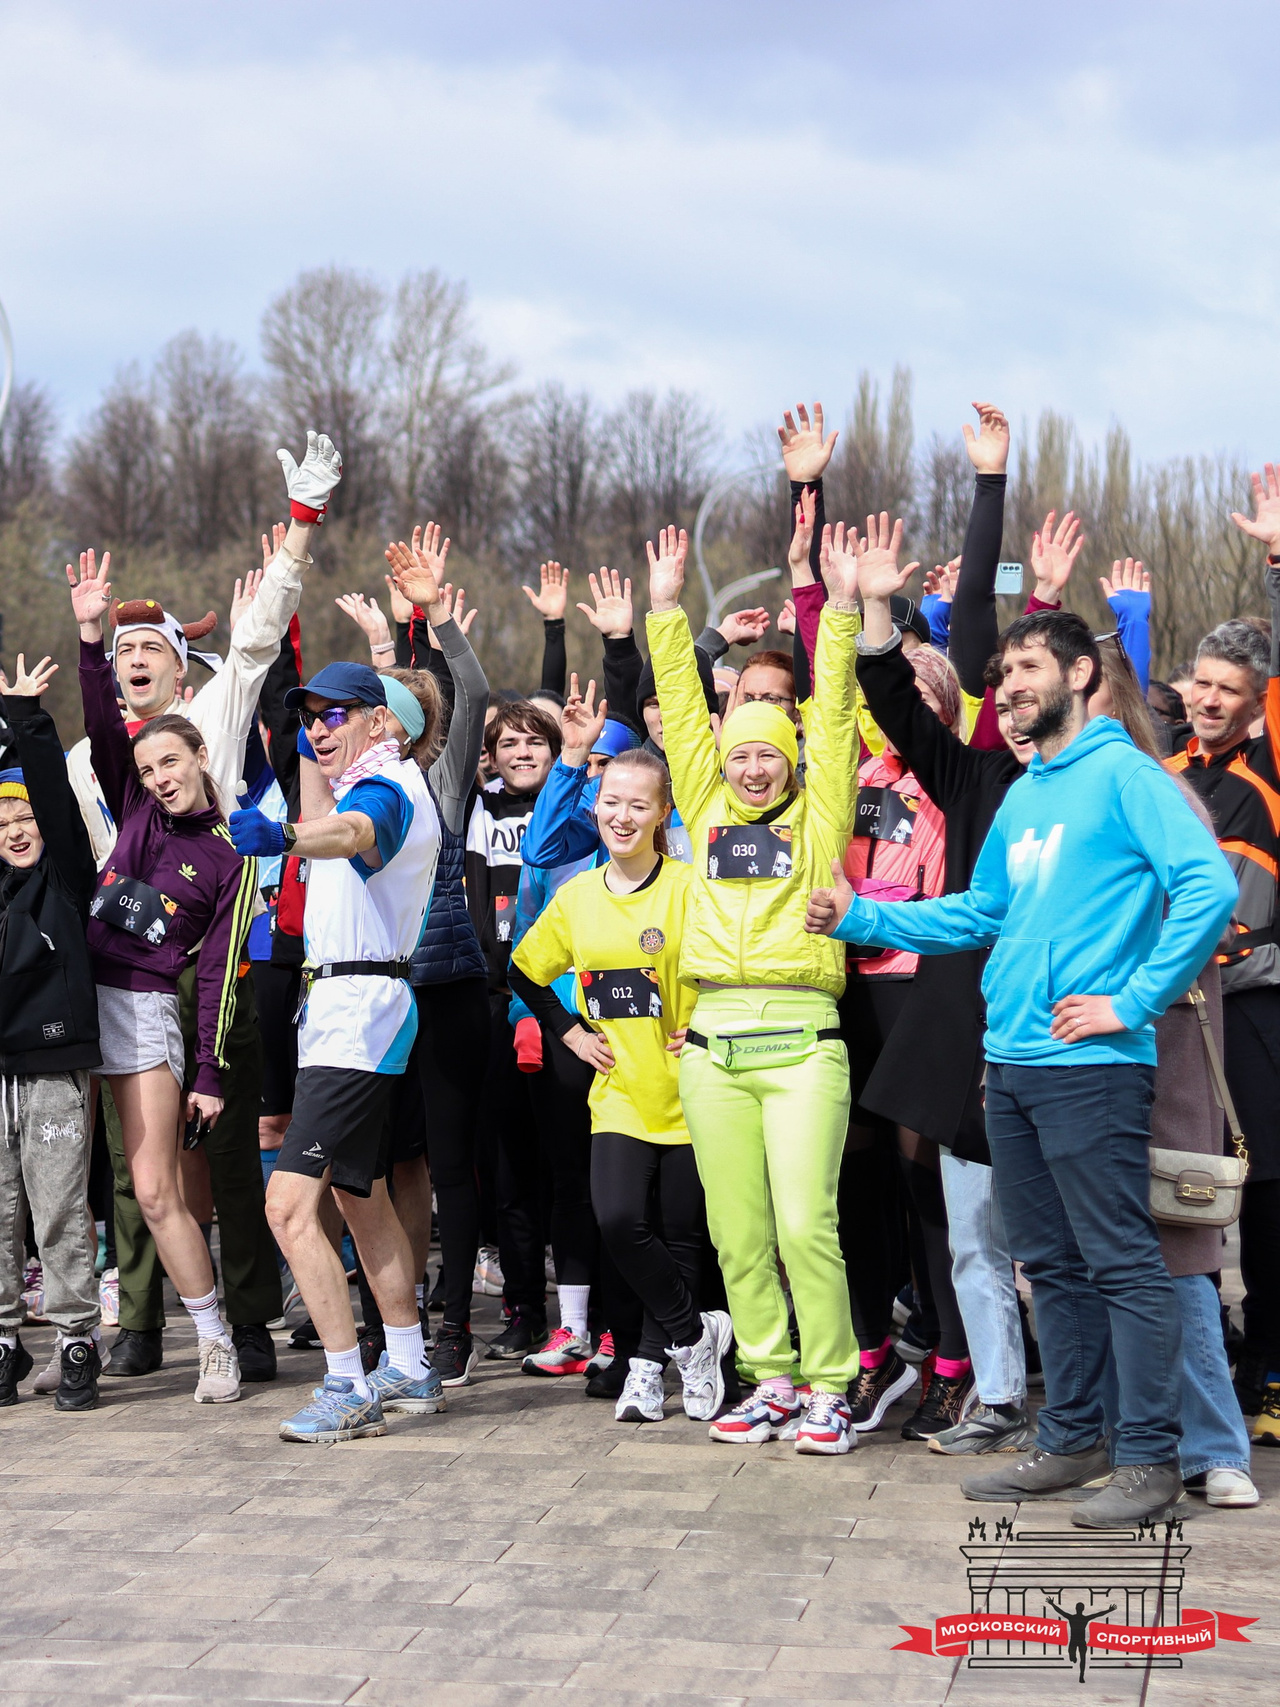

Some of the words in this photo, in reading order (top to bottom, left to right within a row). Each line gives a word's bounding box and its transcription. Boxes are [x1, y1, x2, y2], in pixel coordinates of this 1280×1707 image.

[860, 804, 881, 818] 071
[731, 843, 758, 857] 030
[118, 894, 143, 913] 016
[611, 986, 634, 1000] 012
[743, 1043, 793, 1054] DEMIX
[302, 1150, 325, 1160] DEMIX
